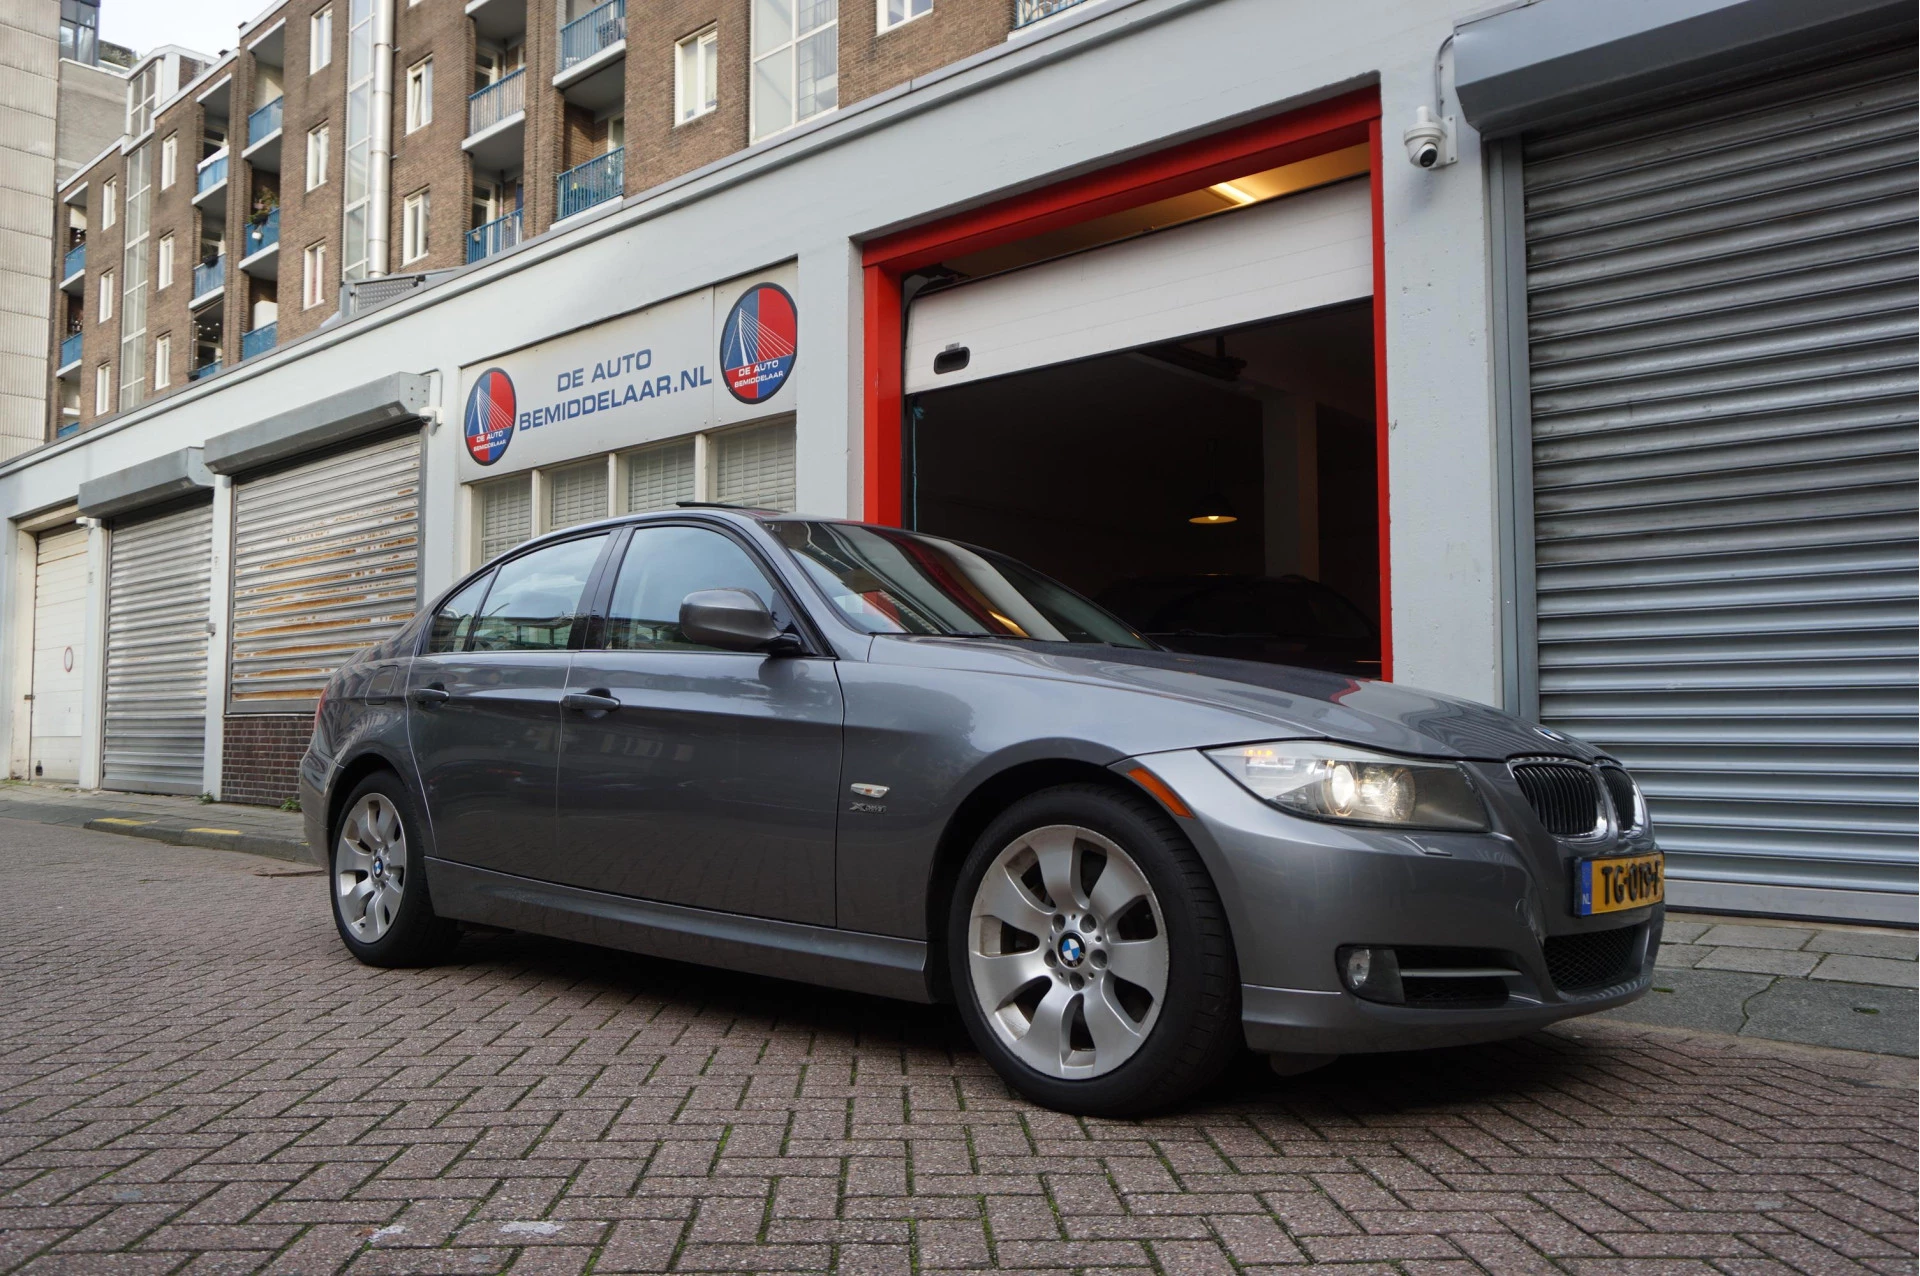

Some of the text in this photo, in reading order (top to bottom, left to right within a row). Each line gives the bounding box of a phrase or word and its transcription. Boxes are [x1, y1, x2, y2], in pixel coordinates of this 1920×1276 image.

[557, 348, 652, 393] DE AUTO
[738, 359, 779, 377] DE AUTO
[734, 370, 784, 388] BEMIDDELAAR
[519, 365, 713, 432] BEMIDDELAAR.NL
[476, 430, 504, 443] DE AUTO
[1582, 893, 1592, 905] NL
